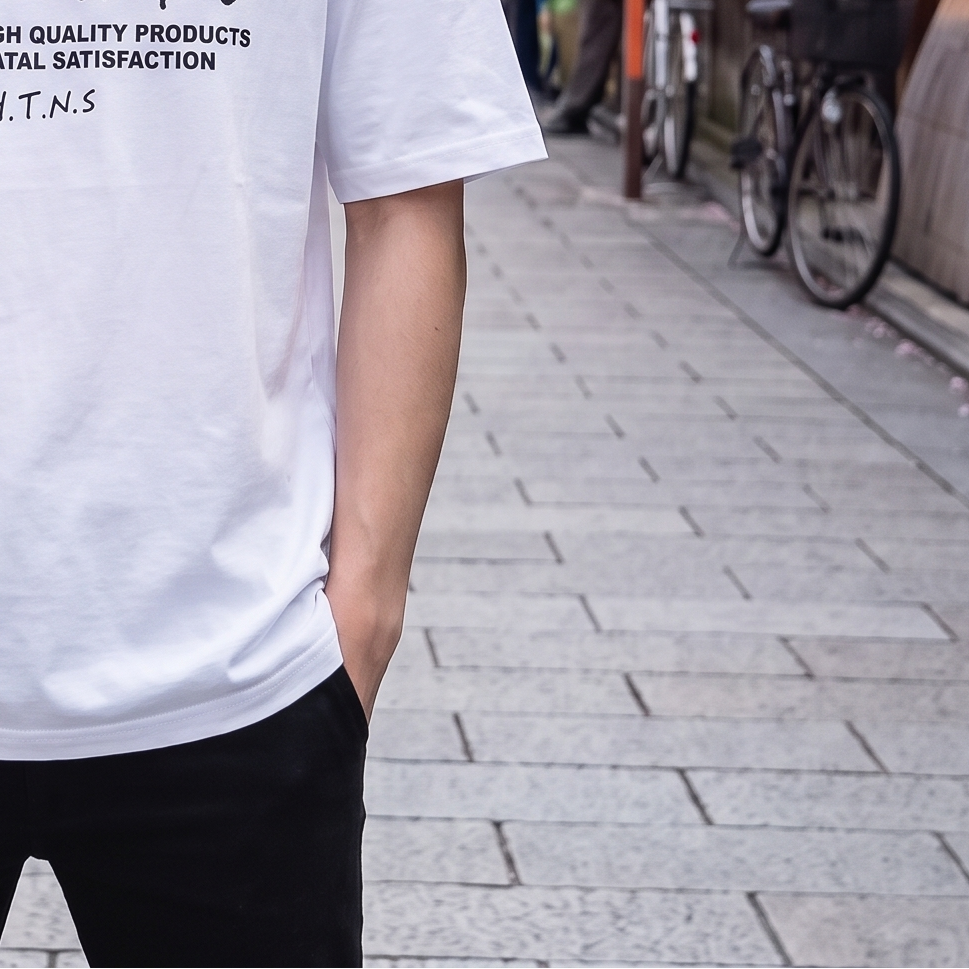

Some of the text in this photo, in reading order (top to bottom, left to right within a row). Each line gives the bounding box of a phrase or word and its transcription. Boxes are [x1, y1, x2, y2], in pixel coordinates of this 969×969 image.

[29, 24, 128, 46] QUALITY
[135, 24, 251, 48] PRODUCTS
[52, 49, 216, 71] SATISFACTION
